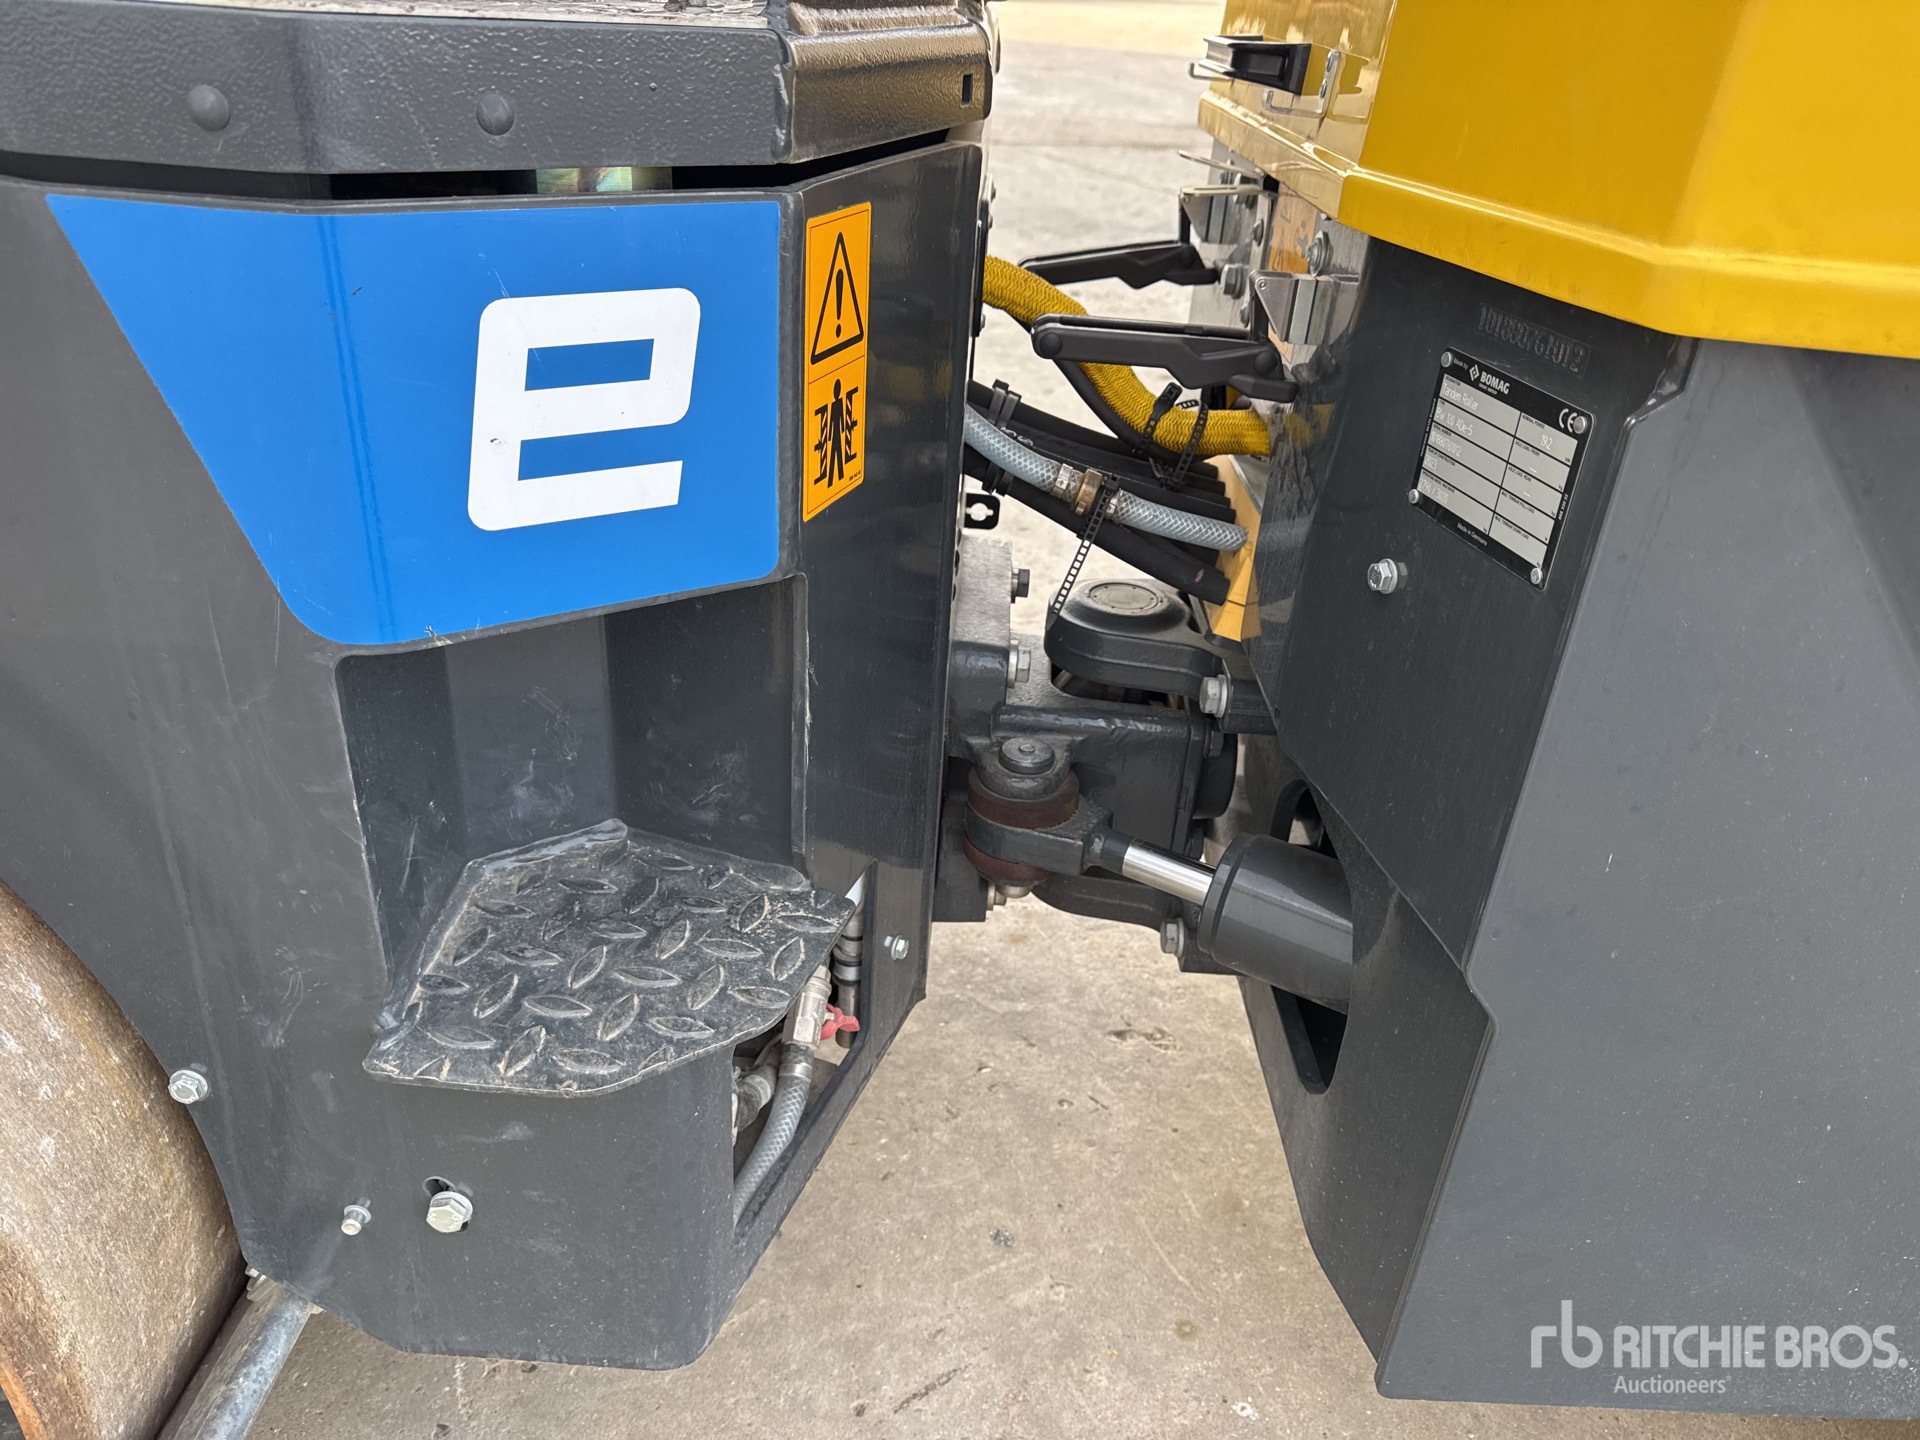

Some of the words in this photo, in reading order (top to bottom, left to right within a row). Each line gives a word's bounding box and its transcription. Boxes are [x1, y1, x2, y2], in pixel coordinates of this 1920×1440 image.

[1442, 381, 1462, 402] Tandem
[1462, 392, 1479, 411] Roller
[1480, 371, 1510, 395] BOMAG
[467, 287, 701, 531] e
